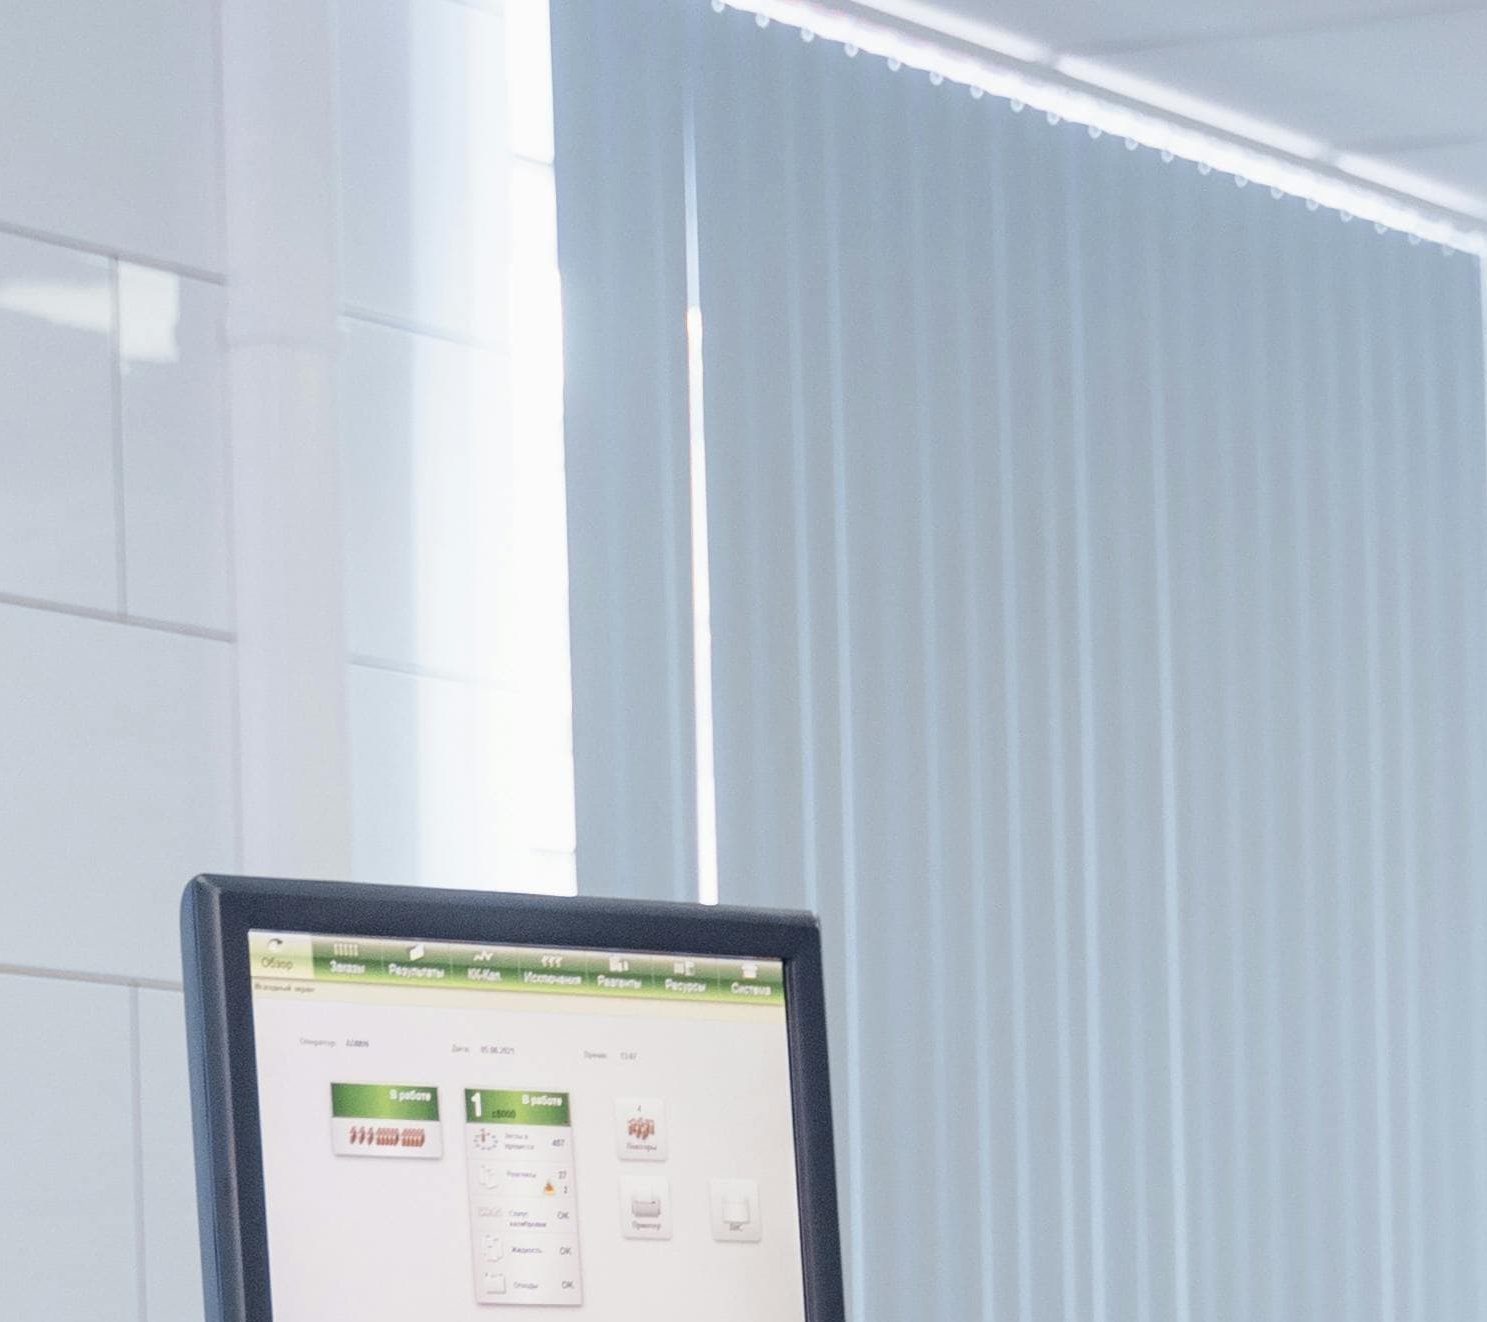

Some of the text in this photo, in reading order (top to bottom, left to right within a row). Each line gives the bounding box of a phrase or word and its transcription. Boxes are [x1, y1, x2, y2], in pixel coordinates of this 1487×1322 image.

[388, 962, 445, 979] Результаты
[731, 982, 771, 996] Система
[471, 1092, 482, 1117] 1
